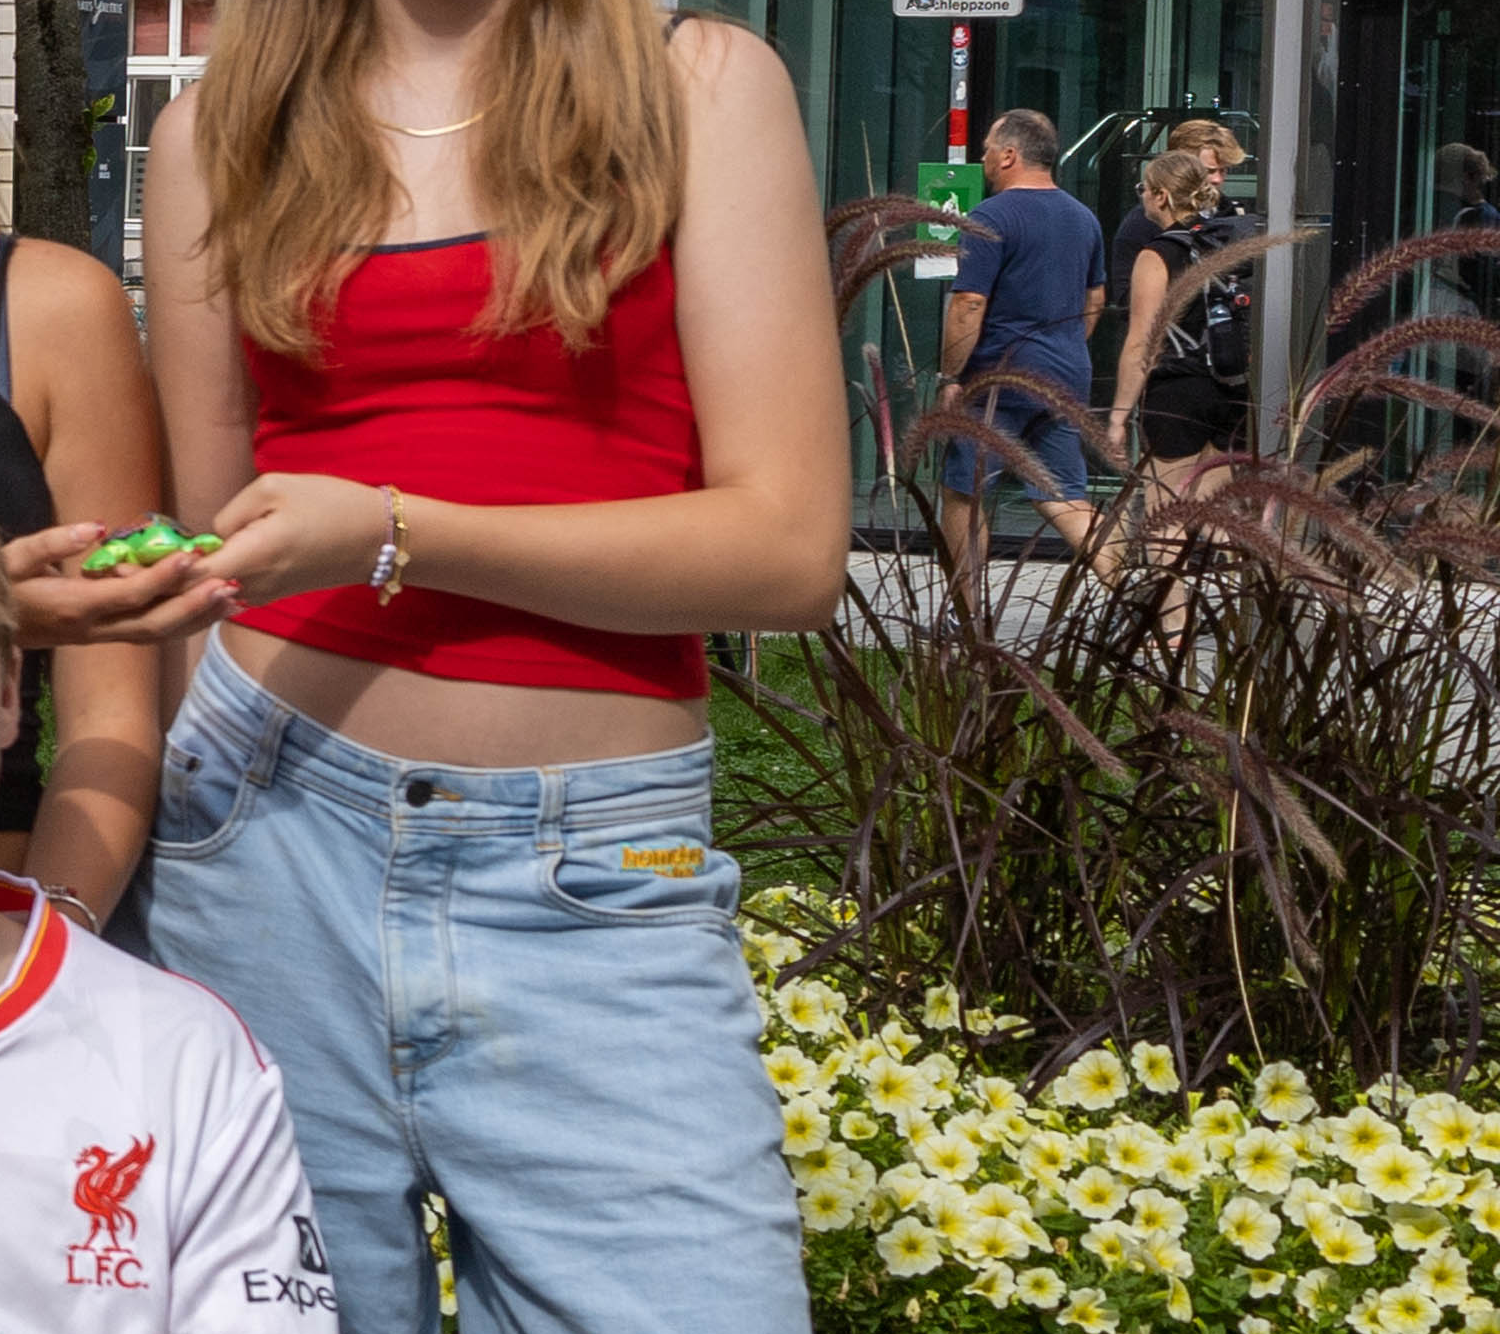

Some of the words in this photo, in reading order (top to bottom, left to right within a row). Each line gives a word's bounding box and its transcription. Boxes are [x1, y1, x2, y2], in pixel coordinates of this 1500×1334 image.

[906, 0, 1010, 13] Achleppzone
[67, 1254, 150, 1289] L.F.C.
[243, 1269, 339, 1314] Expe
